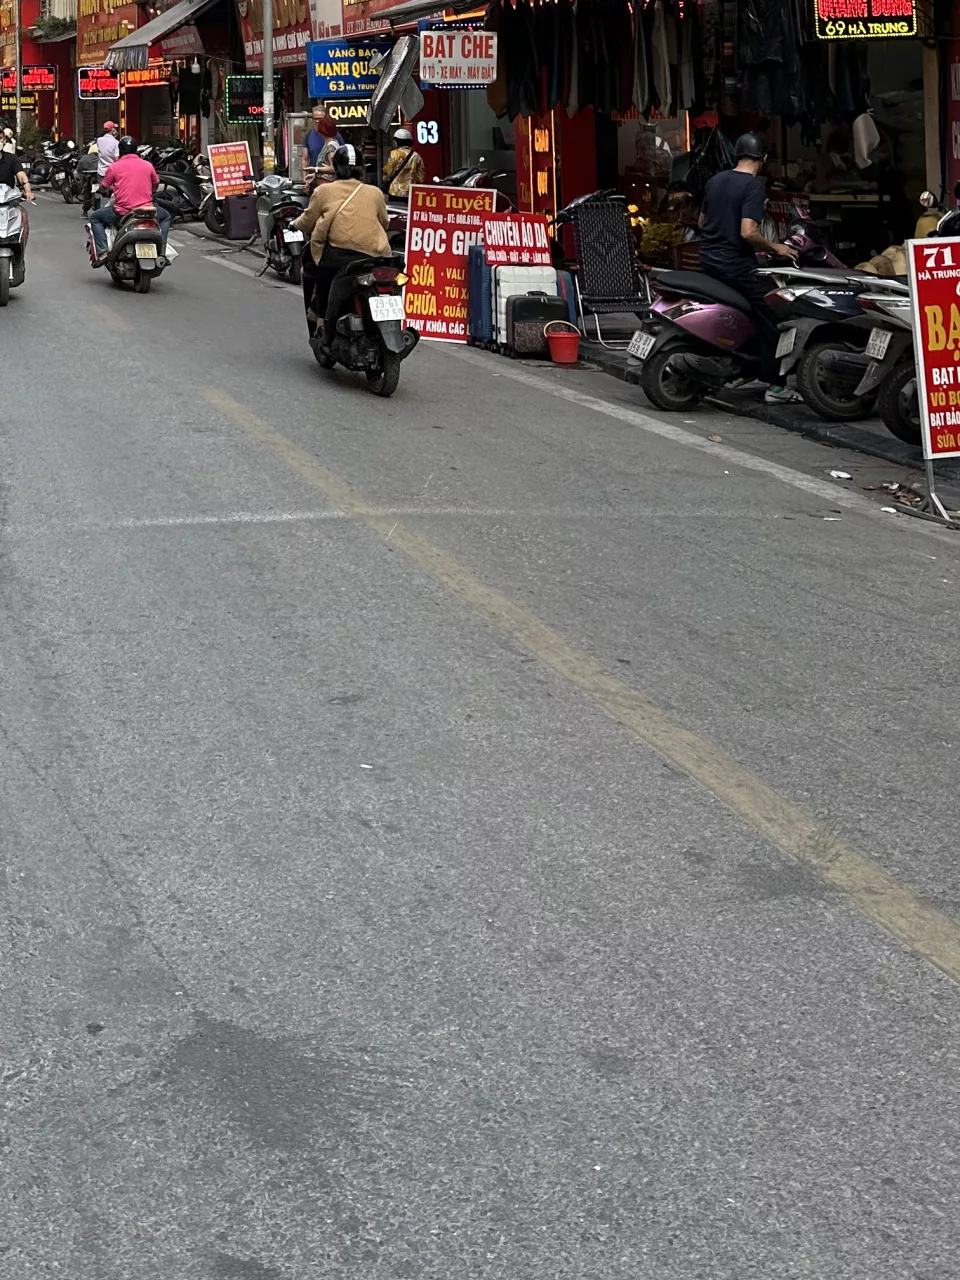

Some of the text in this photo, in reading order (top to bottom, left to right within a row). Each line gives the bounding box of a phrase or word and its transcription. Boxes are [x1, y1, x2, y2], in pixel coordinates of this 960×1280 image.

[826, 21, 909, 36] 69 HÀ TRUNG
[328, 48, 379, 60] VÀNG BẠC
[423, 34, 494, 63] BẠT CHE
[315, 61, 380, 80] MẠNH QUA
[440, 65, 448, 79] XE
[449, 63, 462, 79] MÁY
[467, 63, 480, 79] MÁY
[329, 81, 345, 91] 63
[346, 82, 356, 91] HÀ
[329, 105, 368, 120] QUAN
[417, 120, 439, 144] 63
[415, 191, 492, 213] Tú Tuyết
[429, 212, 443, 224] Trung
[485, 216, 548, 248] CHUYÊN ÁO DA
[411, 227, 447, 257] BỌC
[923, 246, 956, 268] 71
[412, 259, 435, 287] SỬA
[446, 267, 465, 280] VALI
[917, 268, 960, 281] HÀ TRUNG
[445, 284, 459, 299] TÚI
[406, 290, 437, 316] CHỮA
[426, 319, 447, 334] KHÓA
[449, 321, 465, 336] CÁC
[932, 367, 955, 389] BẠT
[930, 412, 945, 430] BẠT
